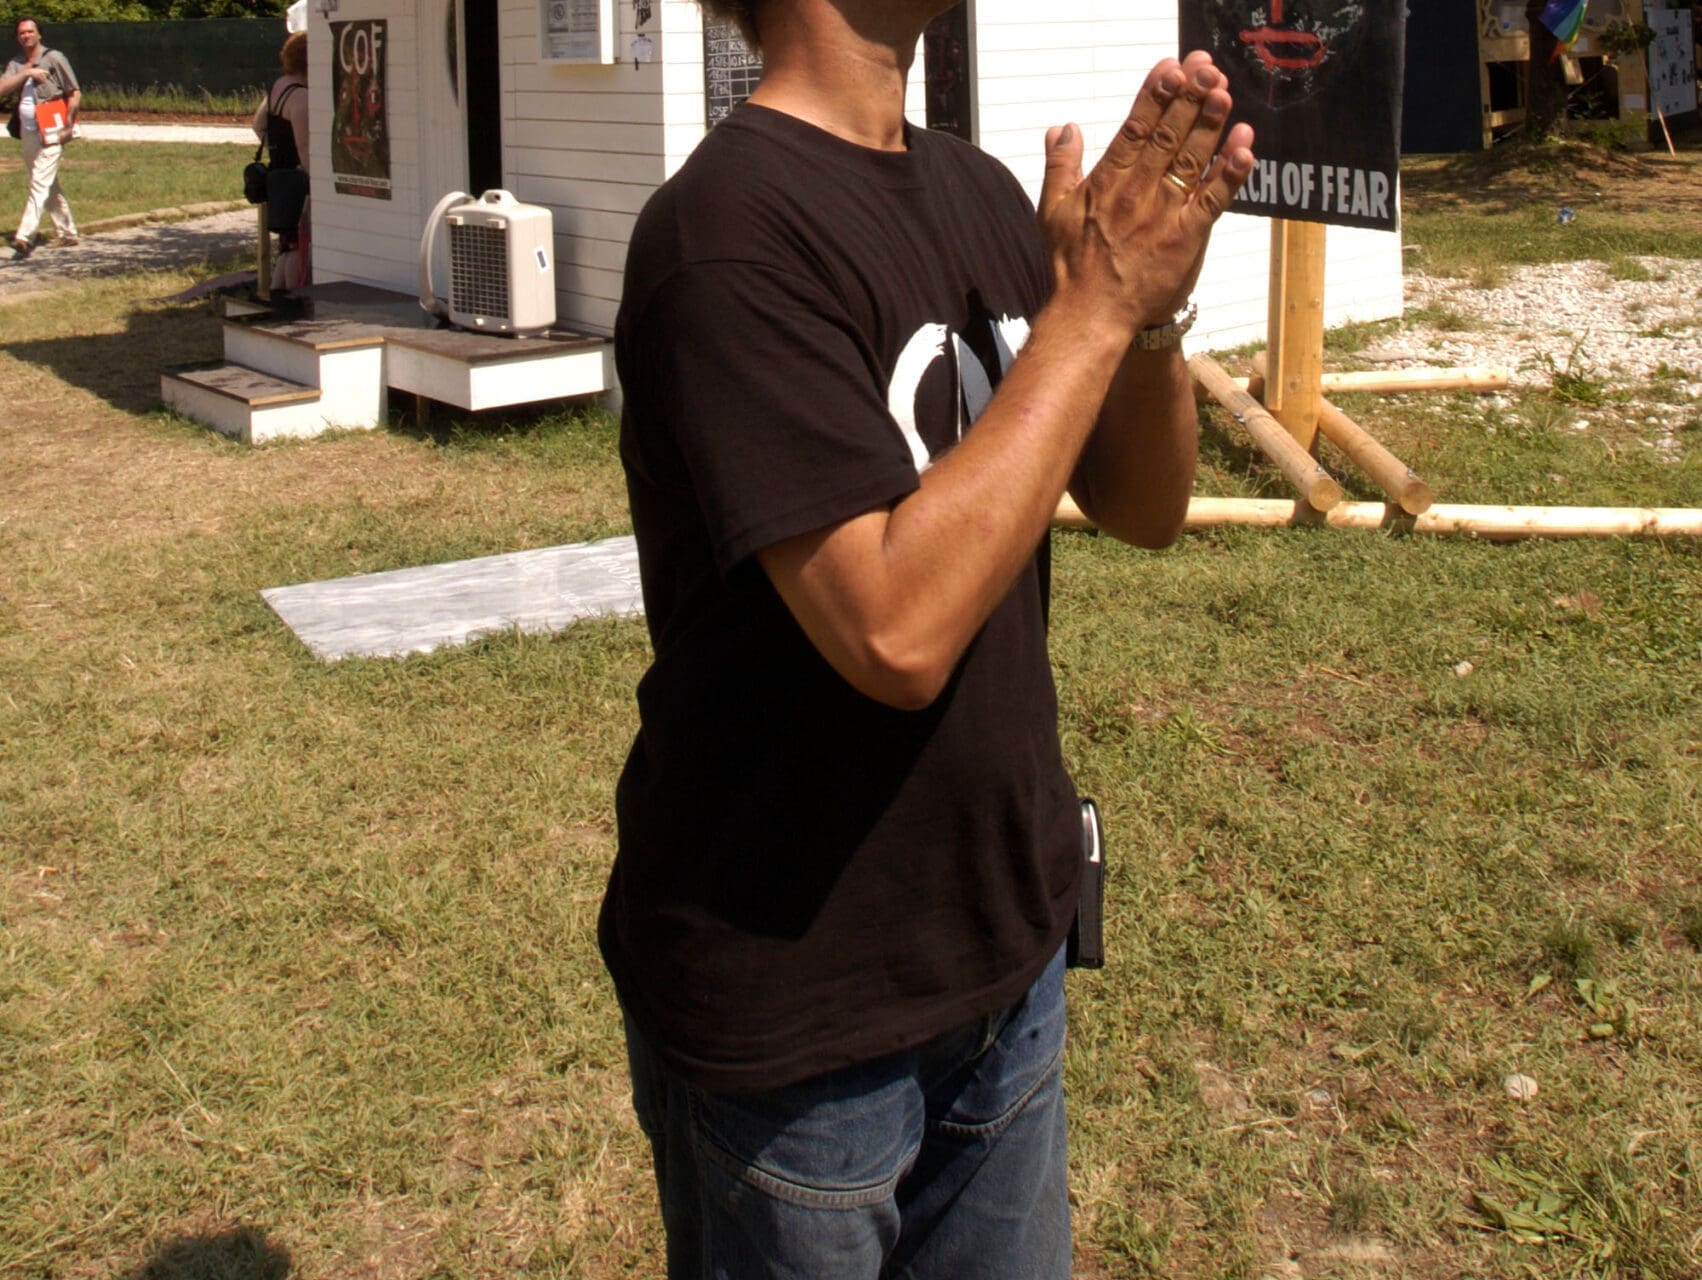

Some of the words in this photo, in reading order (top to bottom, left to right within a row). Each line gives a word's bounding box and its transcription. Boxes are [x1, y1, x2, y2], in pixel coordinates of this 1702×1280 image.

[340, 23, 382, 75] COF
[1281, 162, 1314, 210] OF
[1321, 165, 1390, 219] FEAR
